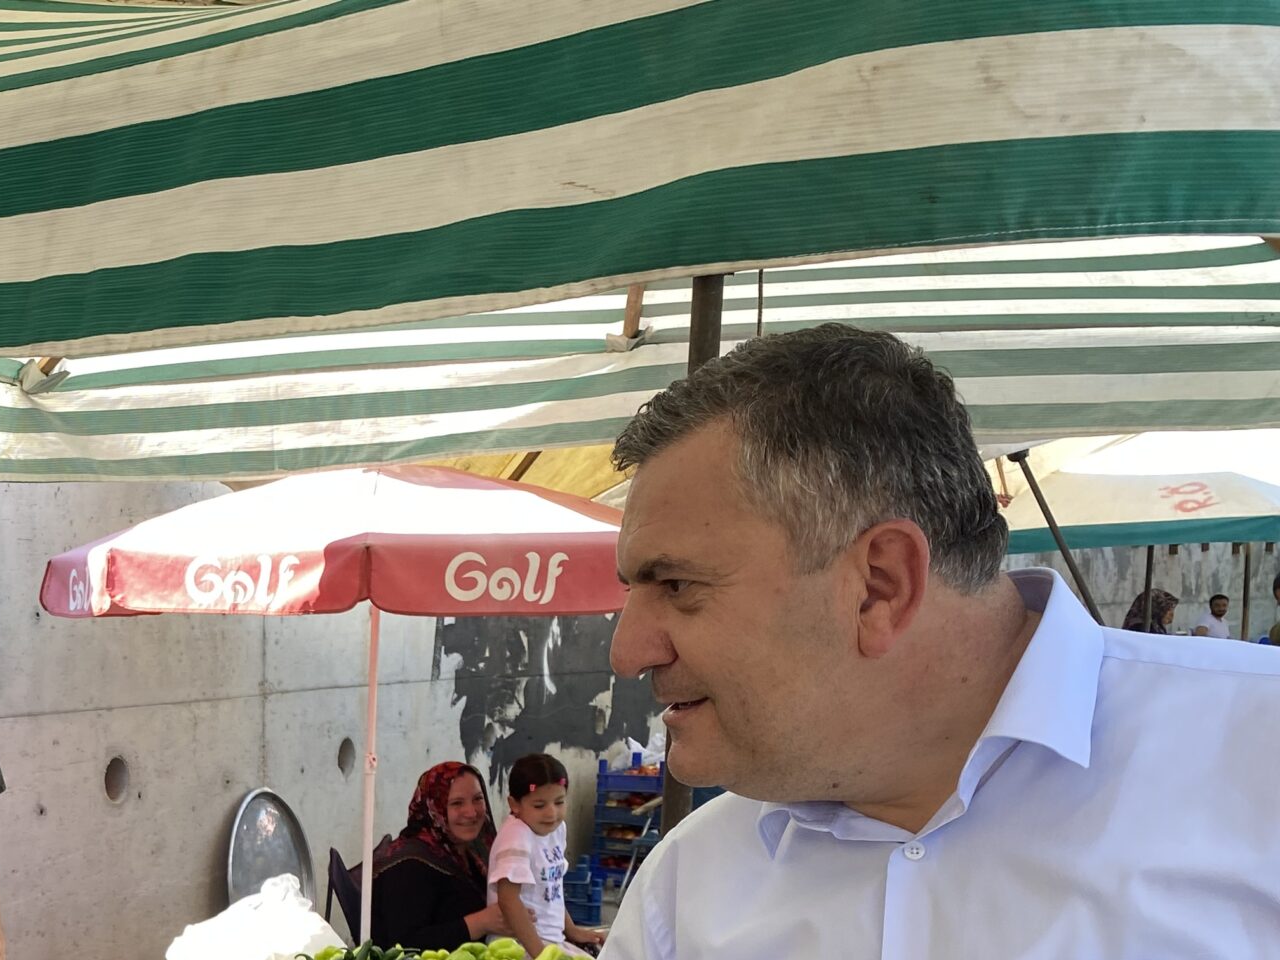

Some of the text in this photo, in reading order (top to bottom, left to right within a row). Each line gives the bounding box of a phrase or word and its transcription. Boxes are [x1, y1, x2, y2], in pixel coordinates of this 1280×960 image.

[69, 568, 92, 612] Gol
[185, 553, 300, 612] Golf
[445, 552, 569, 604] Golf
